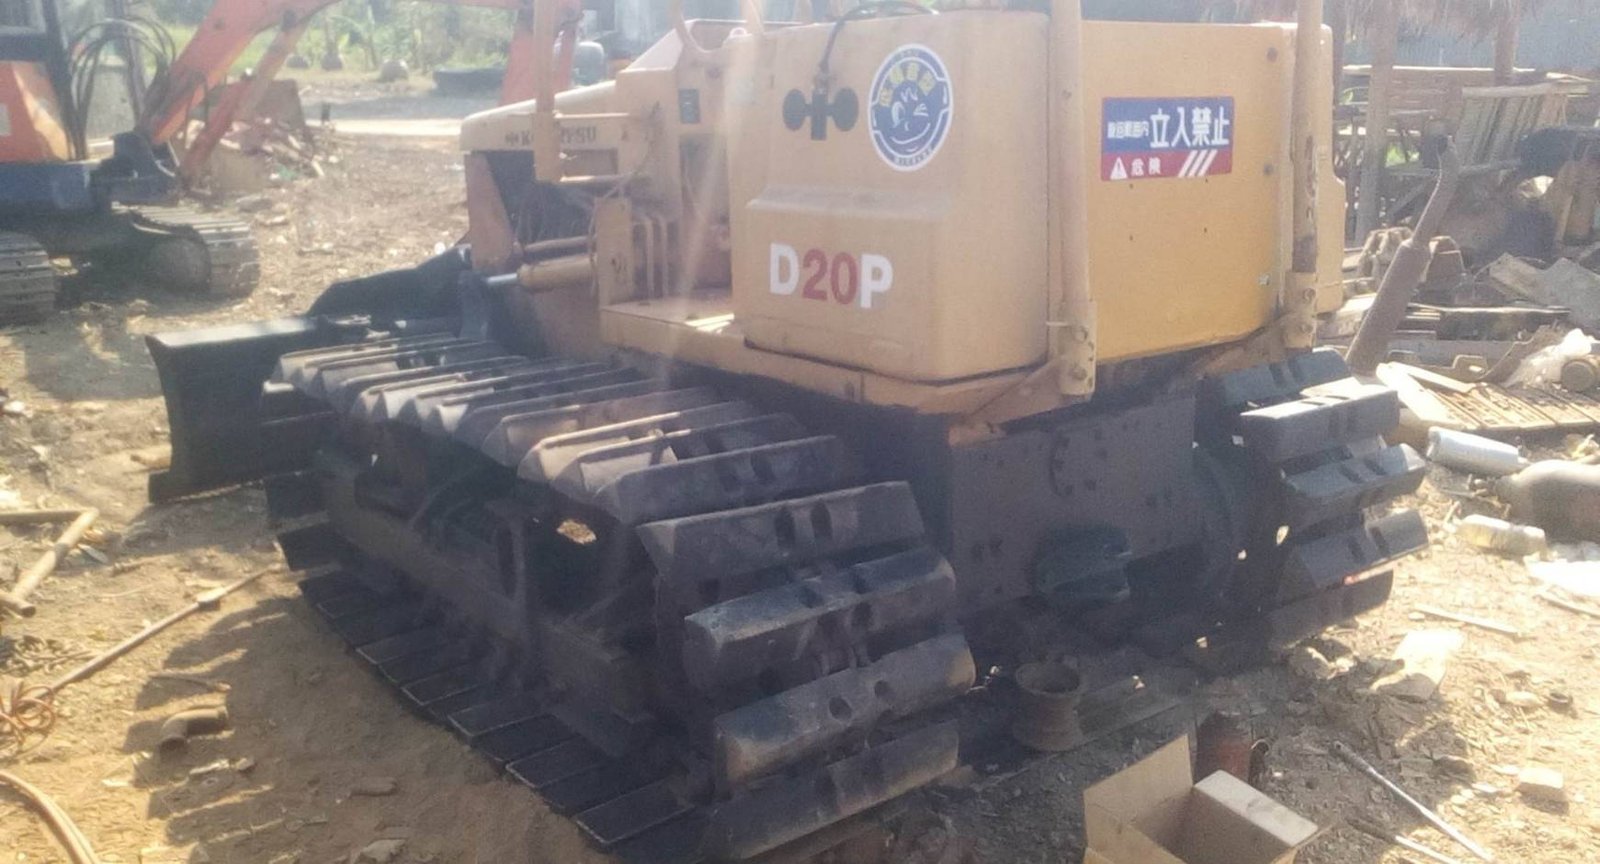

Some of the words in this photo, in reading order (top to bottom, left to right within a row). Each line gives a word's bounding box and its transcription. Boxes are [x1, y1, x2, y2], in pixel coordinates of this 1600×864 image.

[1149, 106, 1230, 148] 立入禁止
[1130, 157, 1161, 176] 危険
[769, 242, 893, 309] D20P
